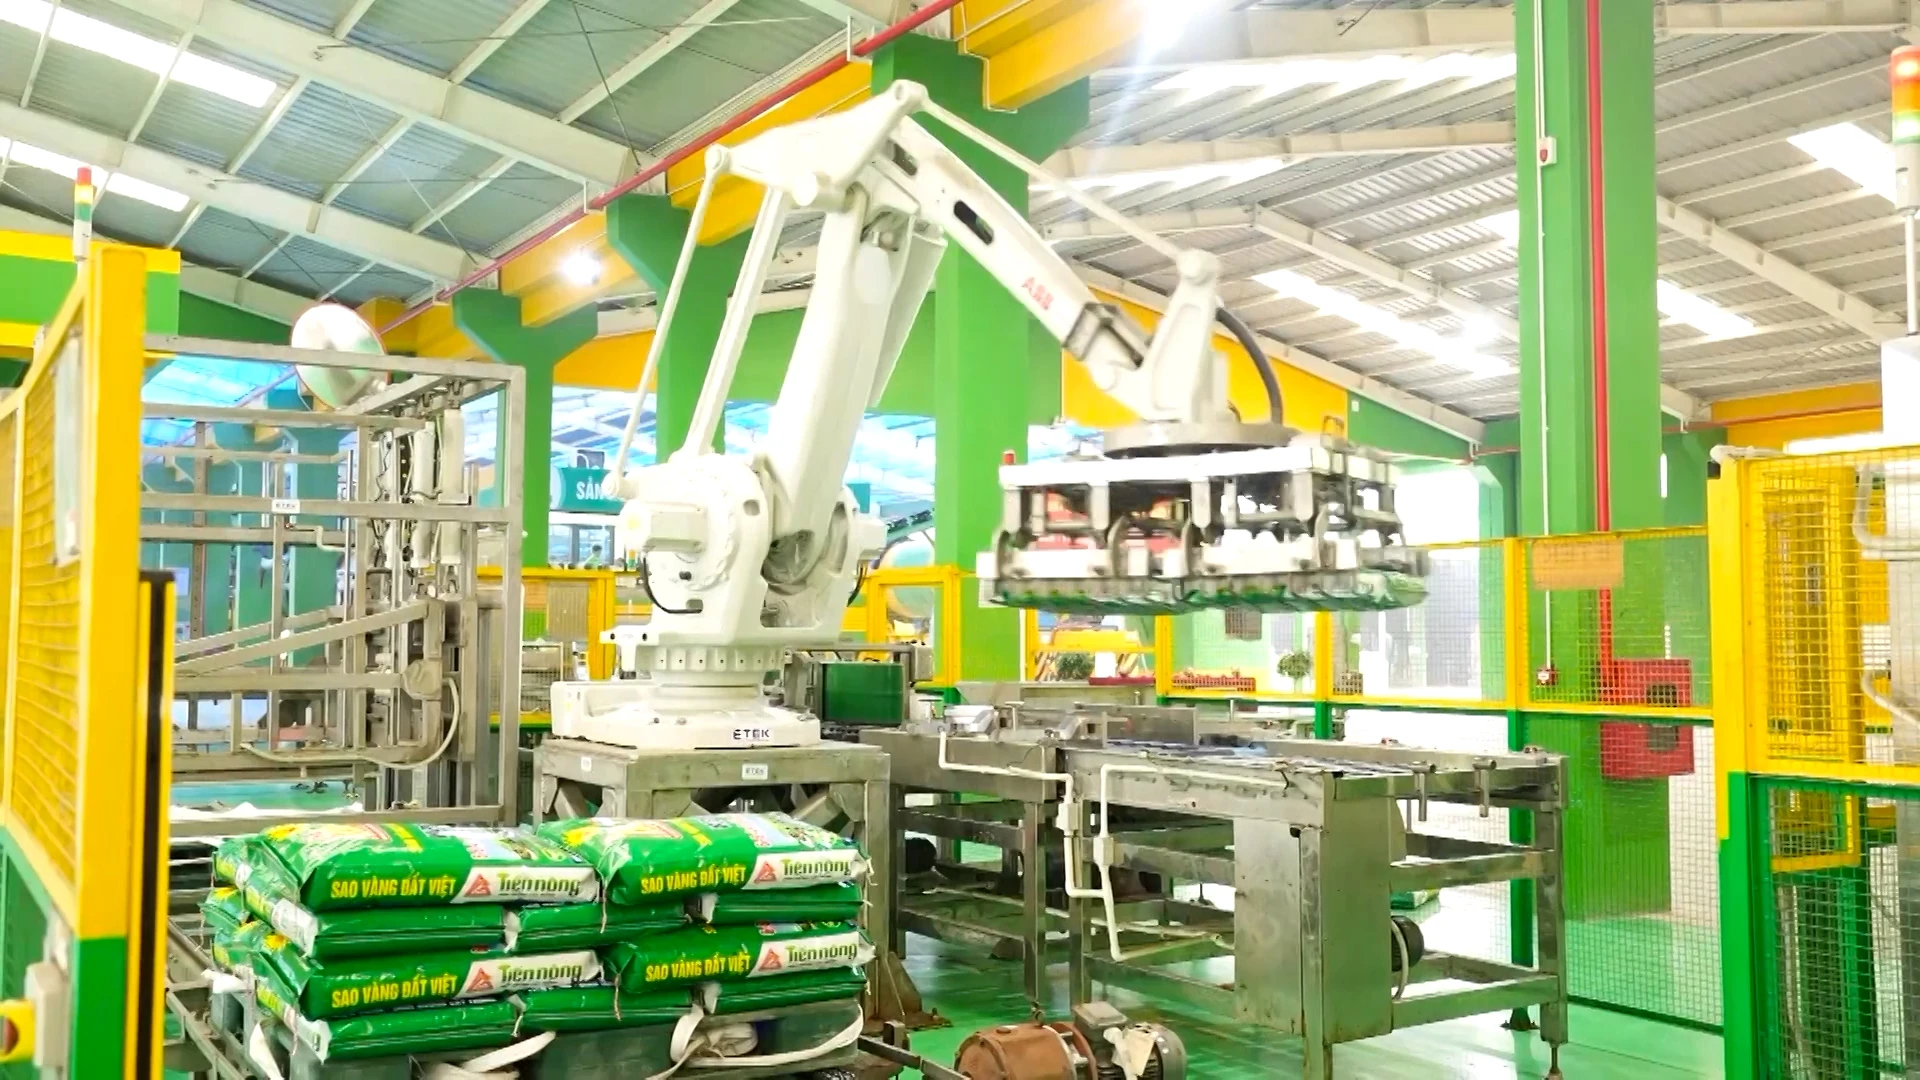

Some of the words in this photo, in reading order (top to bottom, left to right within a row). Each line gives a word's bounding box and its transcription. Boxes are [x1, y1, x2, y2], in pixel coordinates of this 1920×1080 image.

[1021, 276, 1055, 310] ABB
[733, 728, 770, 740] ETEK
[331, 880, 358, 898] SAO
[362, 875, 398, 898] VÀNG
[428, 874, 456, 899] VIỆT
[641, 876, 664, 895] SAO
[666, 870, 697, 891] VÀNG
[722, 863, 746, 886] VIỆT
[645, 963, 669, 982] SAO
[671, 959, 702, 978] VÀNG
[728, 951, 751, 975] VIỆT
[331, 987, 359, 1009] SAO
[362, 981, 399, 1004] VÀNG
[430, 972, 458, 998] VIỆT
